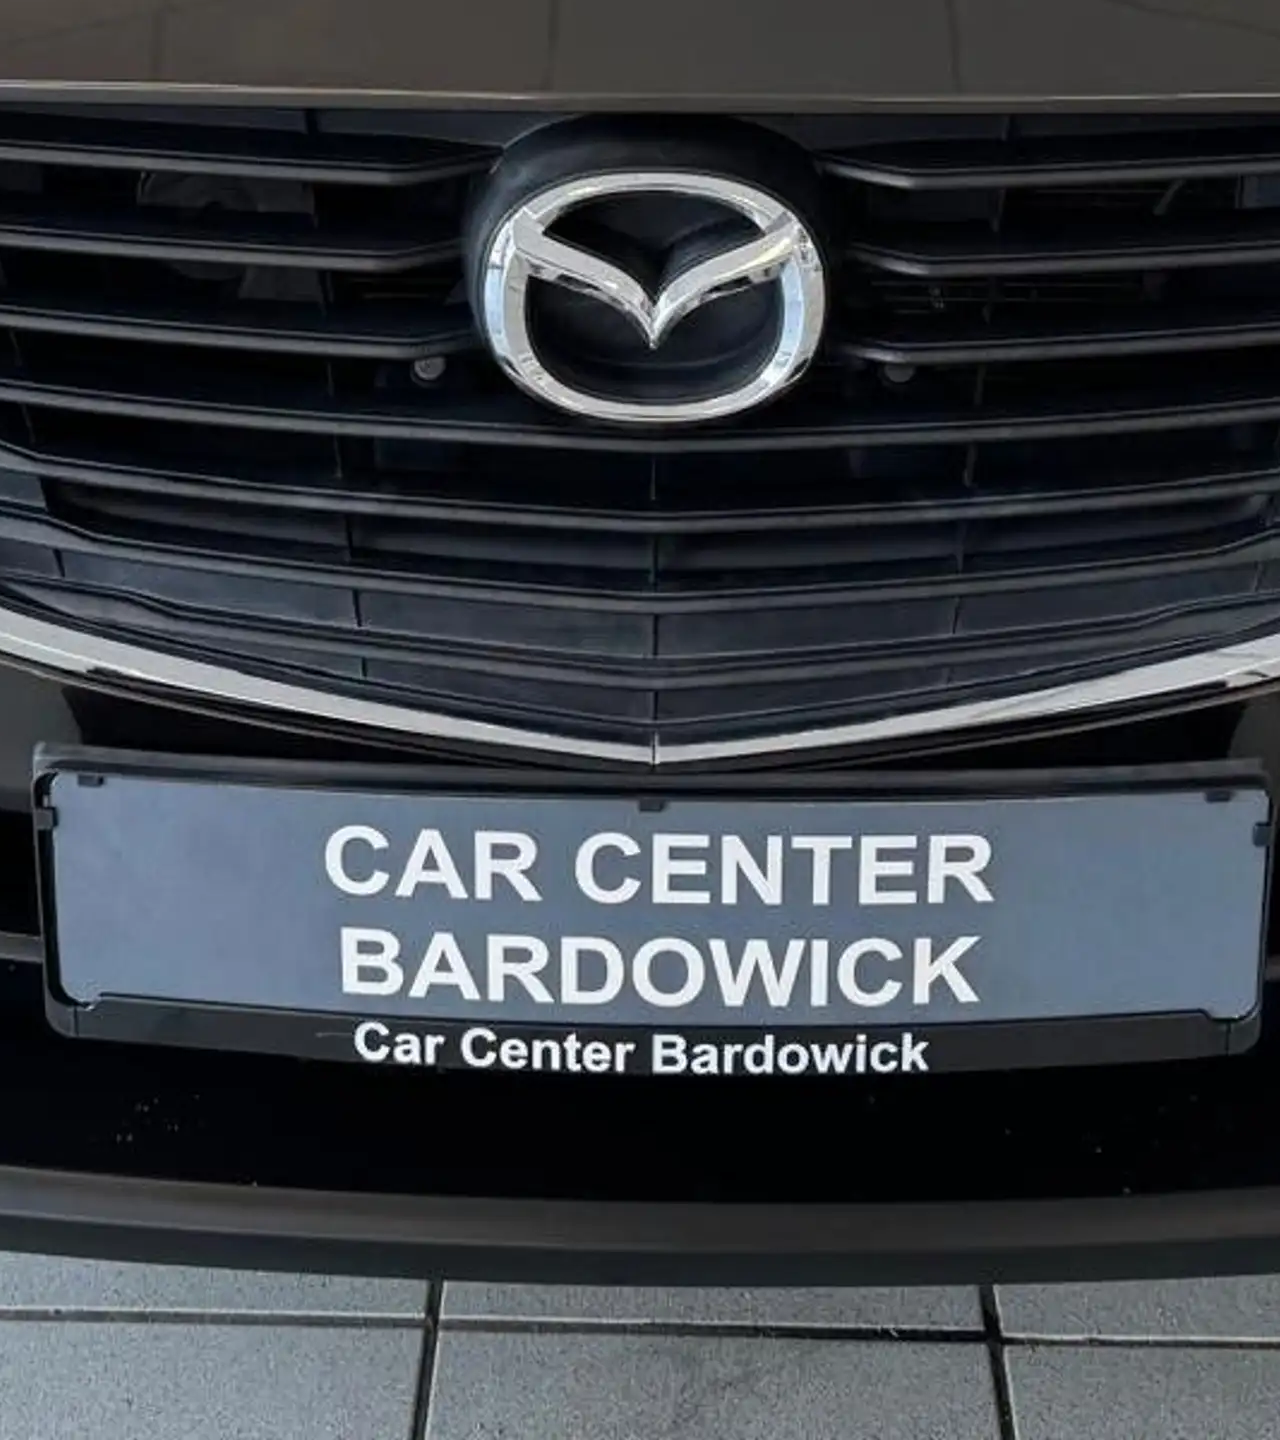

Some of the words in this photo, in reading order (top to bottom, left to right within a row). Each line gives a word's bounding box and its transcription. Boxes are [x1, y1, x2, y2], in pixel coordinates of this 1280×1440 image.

[324, 824, 543, 901] CAR
[574, 832, 994, 905] CENTER
[340, 926, 981, 1008] BARDOWICK
[353, 1020, 446, 1066] Car
[459, 1026, 636, 1073] Center
[651, 1032, 930, 1075] Bardowick
